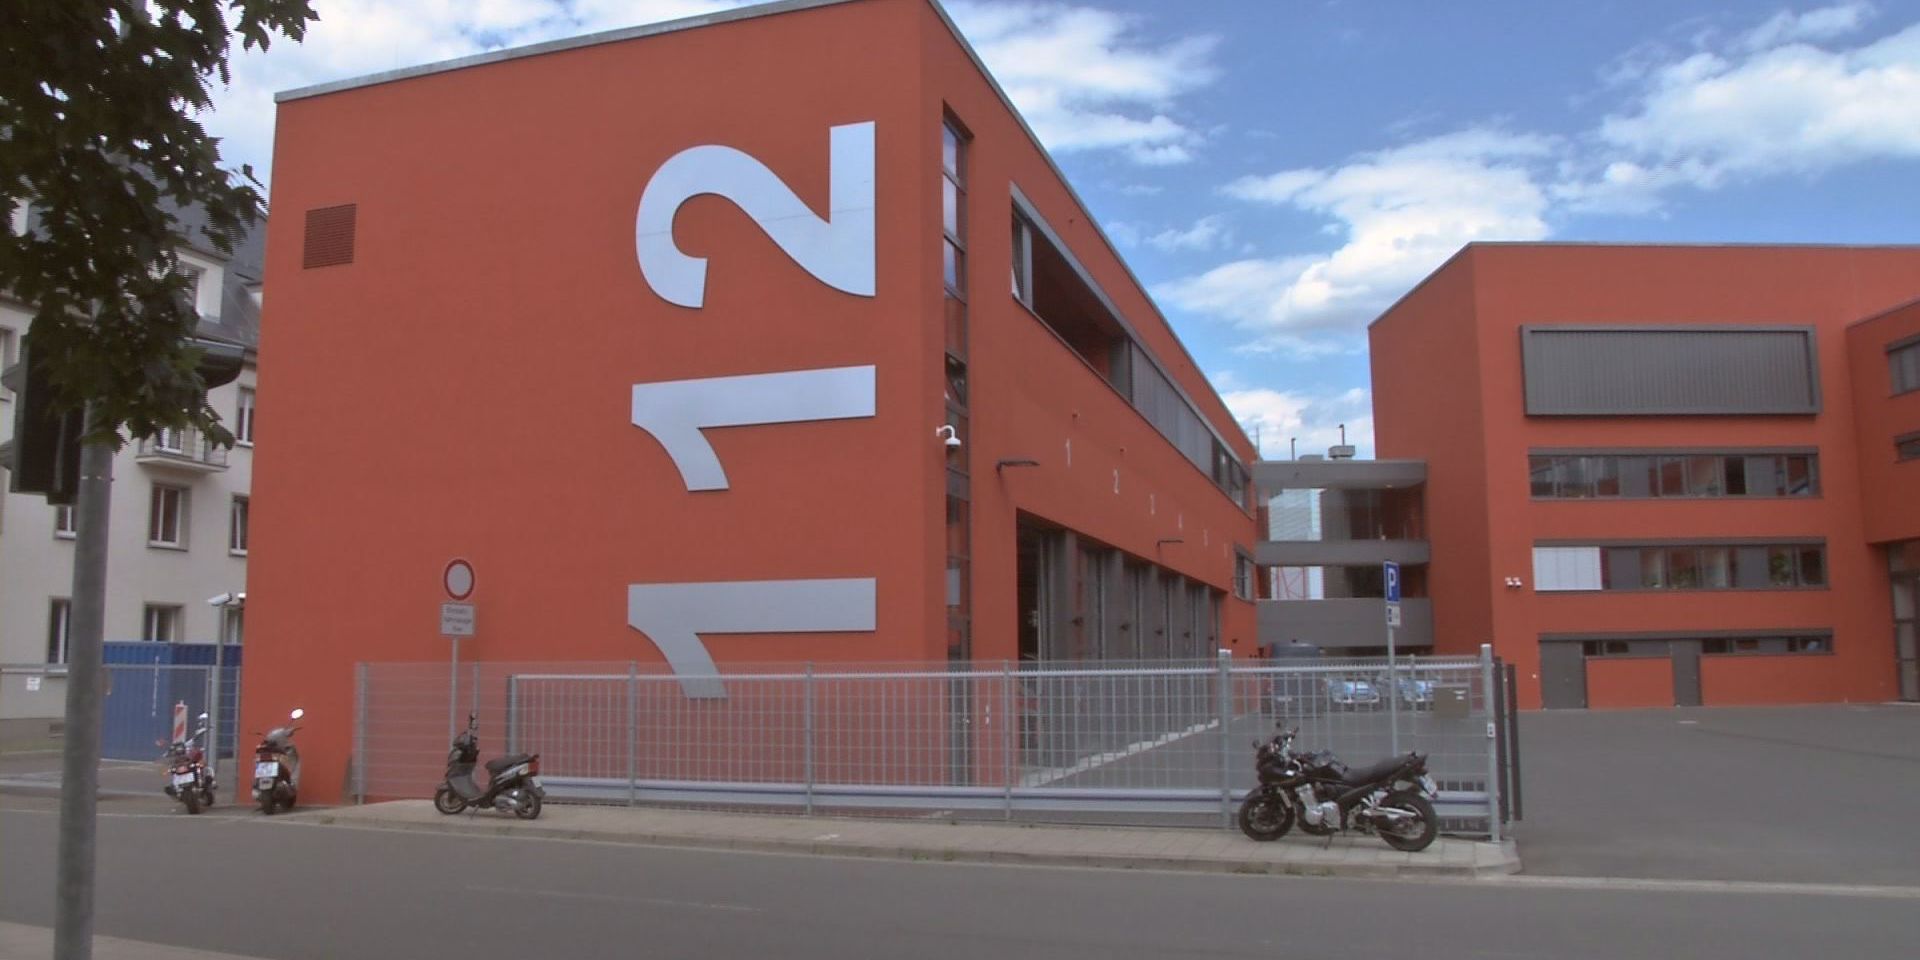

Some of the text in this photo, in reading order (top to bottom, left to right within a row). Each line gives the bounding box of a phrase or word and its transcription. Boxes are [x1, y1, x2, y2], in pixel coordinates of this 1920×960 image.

[628, 121, 876, 699] 112
[1112, 469, 1120, 494] 2
[1387, 567, 1397, 597] P
